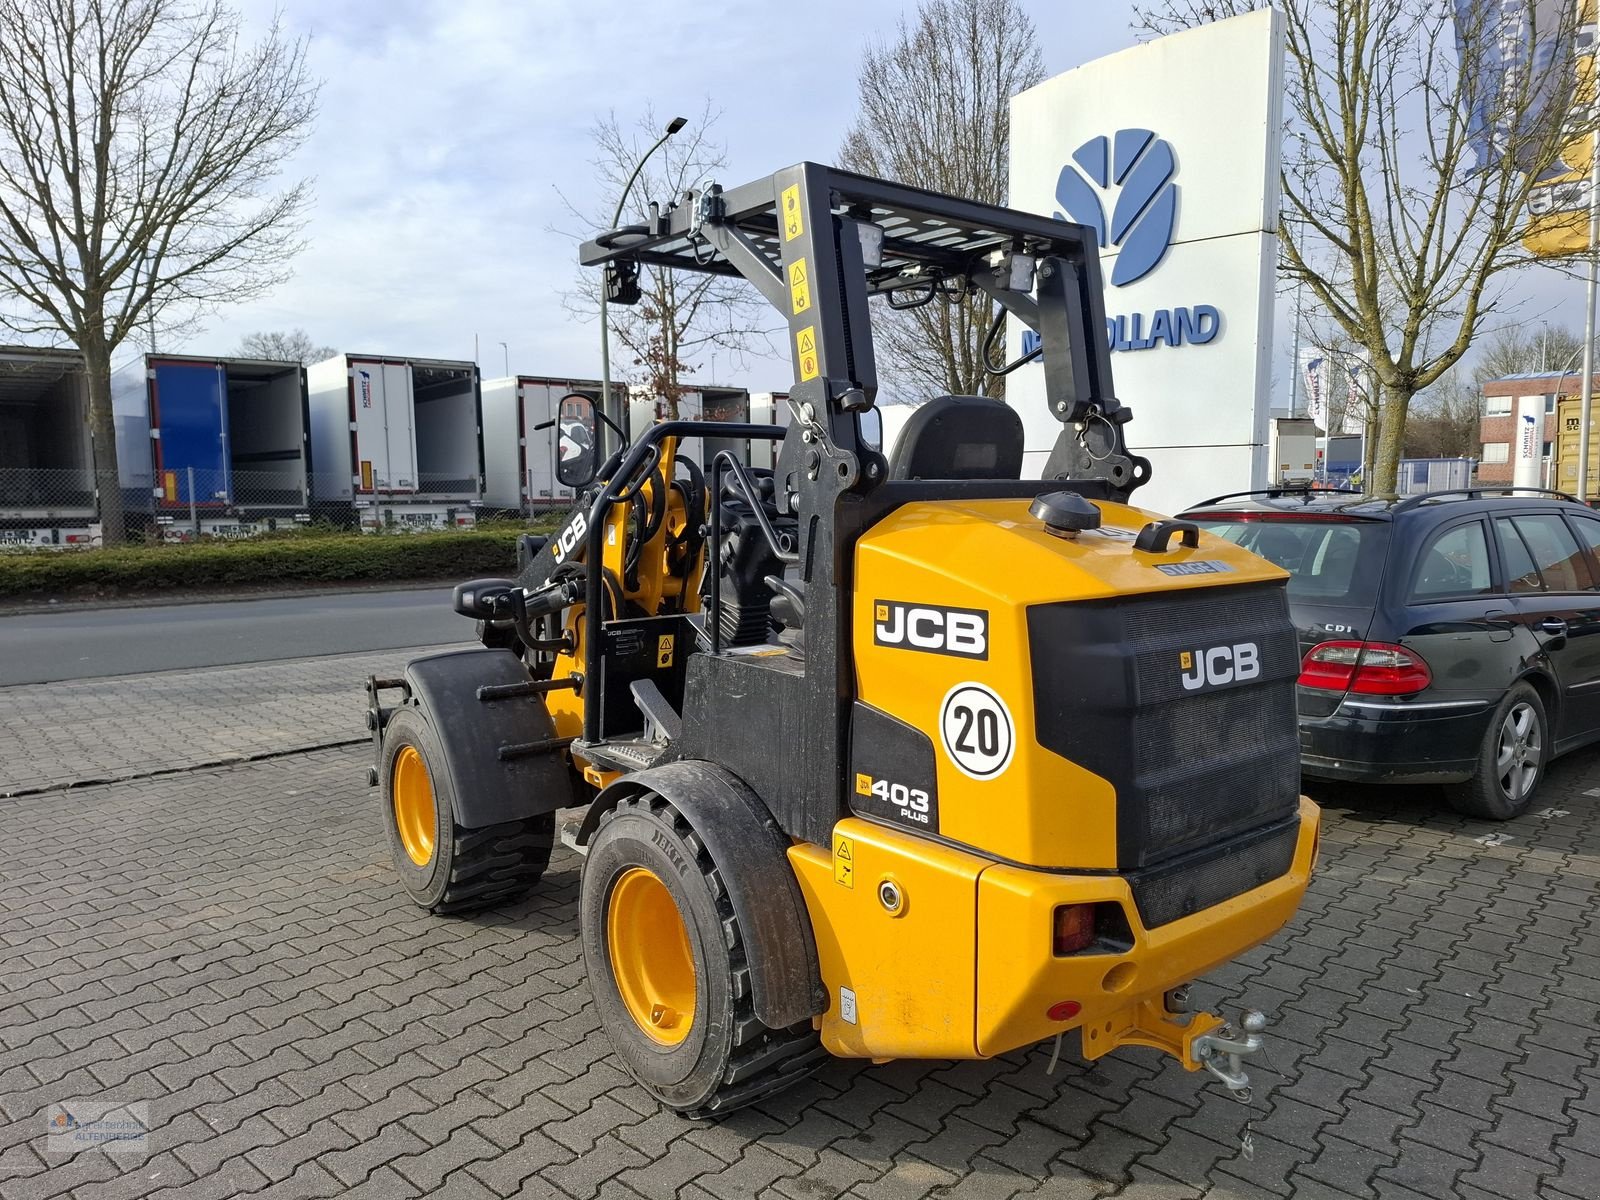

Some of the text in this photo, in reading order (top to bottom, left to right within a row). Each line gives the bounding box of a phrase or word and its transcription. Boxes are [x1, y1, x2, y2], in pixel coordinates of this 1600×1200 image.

[555, 512, 587, 565] JCB
[1157, 561, 1216, 576] STAGE
[876, 606, 986, 655] JCB
[1325, 623, 1352, 633] CDI
[1182, 642, 1260, 691] JCB
[954, 705, 999, 757] 20
[871, 779, 929, 813] 403
[900, 808, 929, 824] PLUS
[658, 837, 681, 862] BKT
